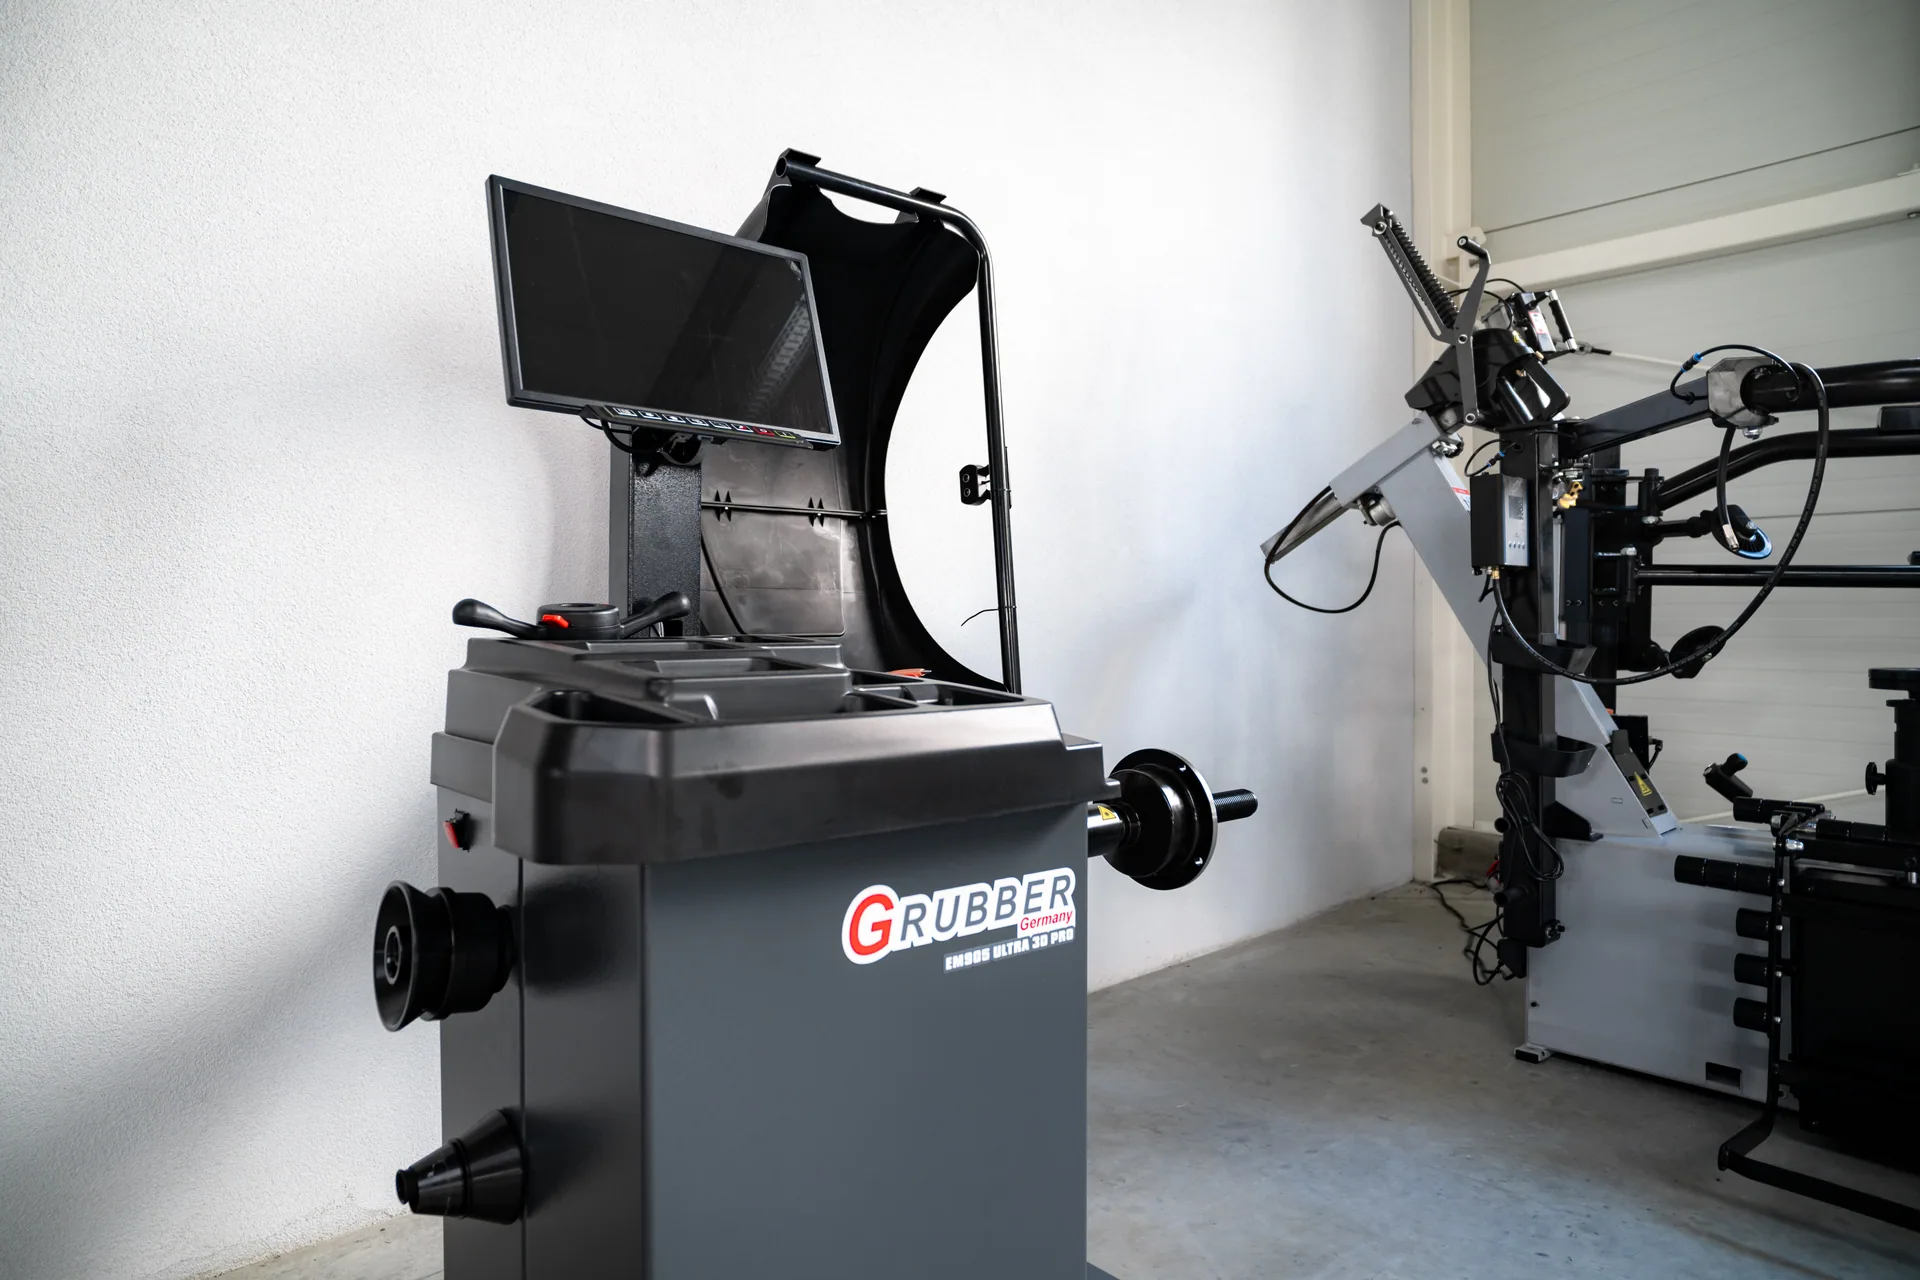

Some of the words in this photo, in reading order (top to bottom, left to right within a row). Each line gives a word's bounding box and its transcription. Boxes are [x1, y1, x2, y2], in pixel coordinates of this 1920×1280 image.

[848, 873, 1072, 957] GRUBBER
[1020, 911, 1073, 931] Germany
[945, 947, 991, 971] EM905
[993, 938, 1030, 959] ULTRA
[1032, 933, 1048, 949] 3D
[1051, 927, 1074, 945] PRO
